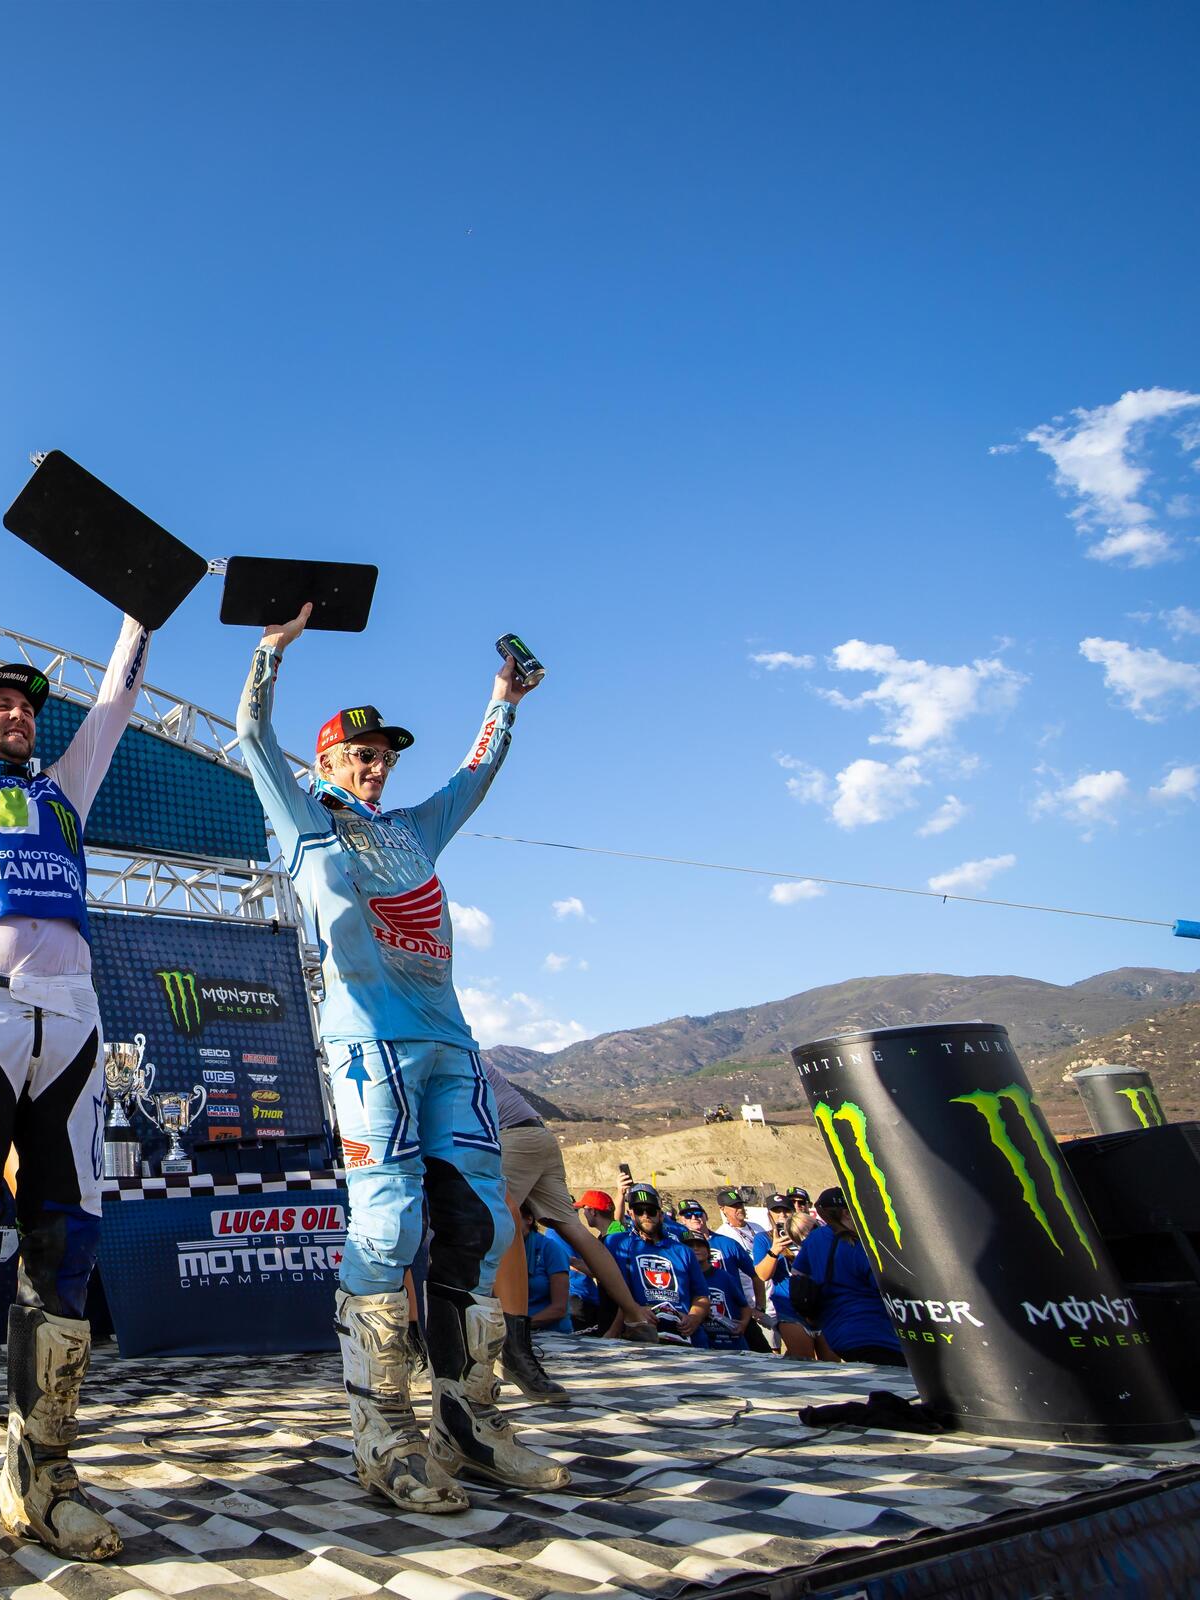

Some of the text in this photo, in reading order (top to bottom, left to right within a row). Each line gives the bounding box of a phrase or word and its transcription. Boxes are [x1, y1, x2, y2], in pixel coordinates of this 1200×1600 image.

[2, 672, 28, 682] YAMAHA
[468, 719, 496, 773] HONDA
[8, 888, 72, 898] alpinestars
[373, 925, 452, 960] HONDA
[201, 987, 279, 1007] MONSTER
[218, 1006, 271, 1015] ENERGY
[200, 1049, 230, 1057] GEICO
[203, 1070, 235, 1083] WPS
[260, 1110, 283, 1118] THOR
[219, 1207, 341, 1234] LUCAS OIL
[253, 1236, 310, 1245] PRO
[178, 1246, 342, 1277] MOTOCRO
[654, 1273, 663, 1284] 1
[645, 1290, 679, 1298] CHAMPION
